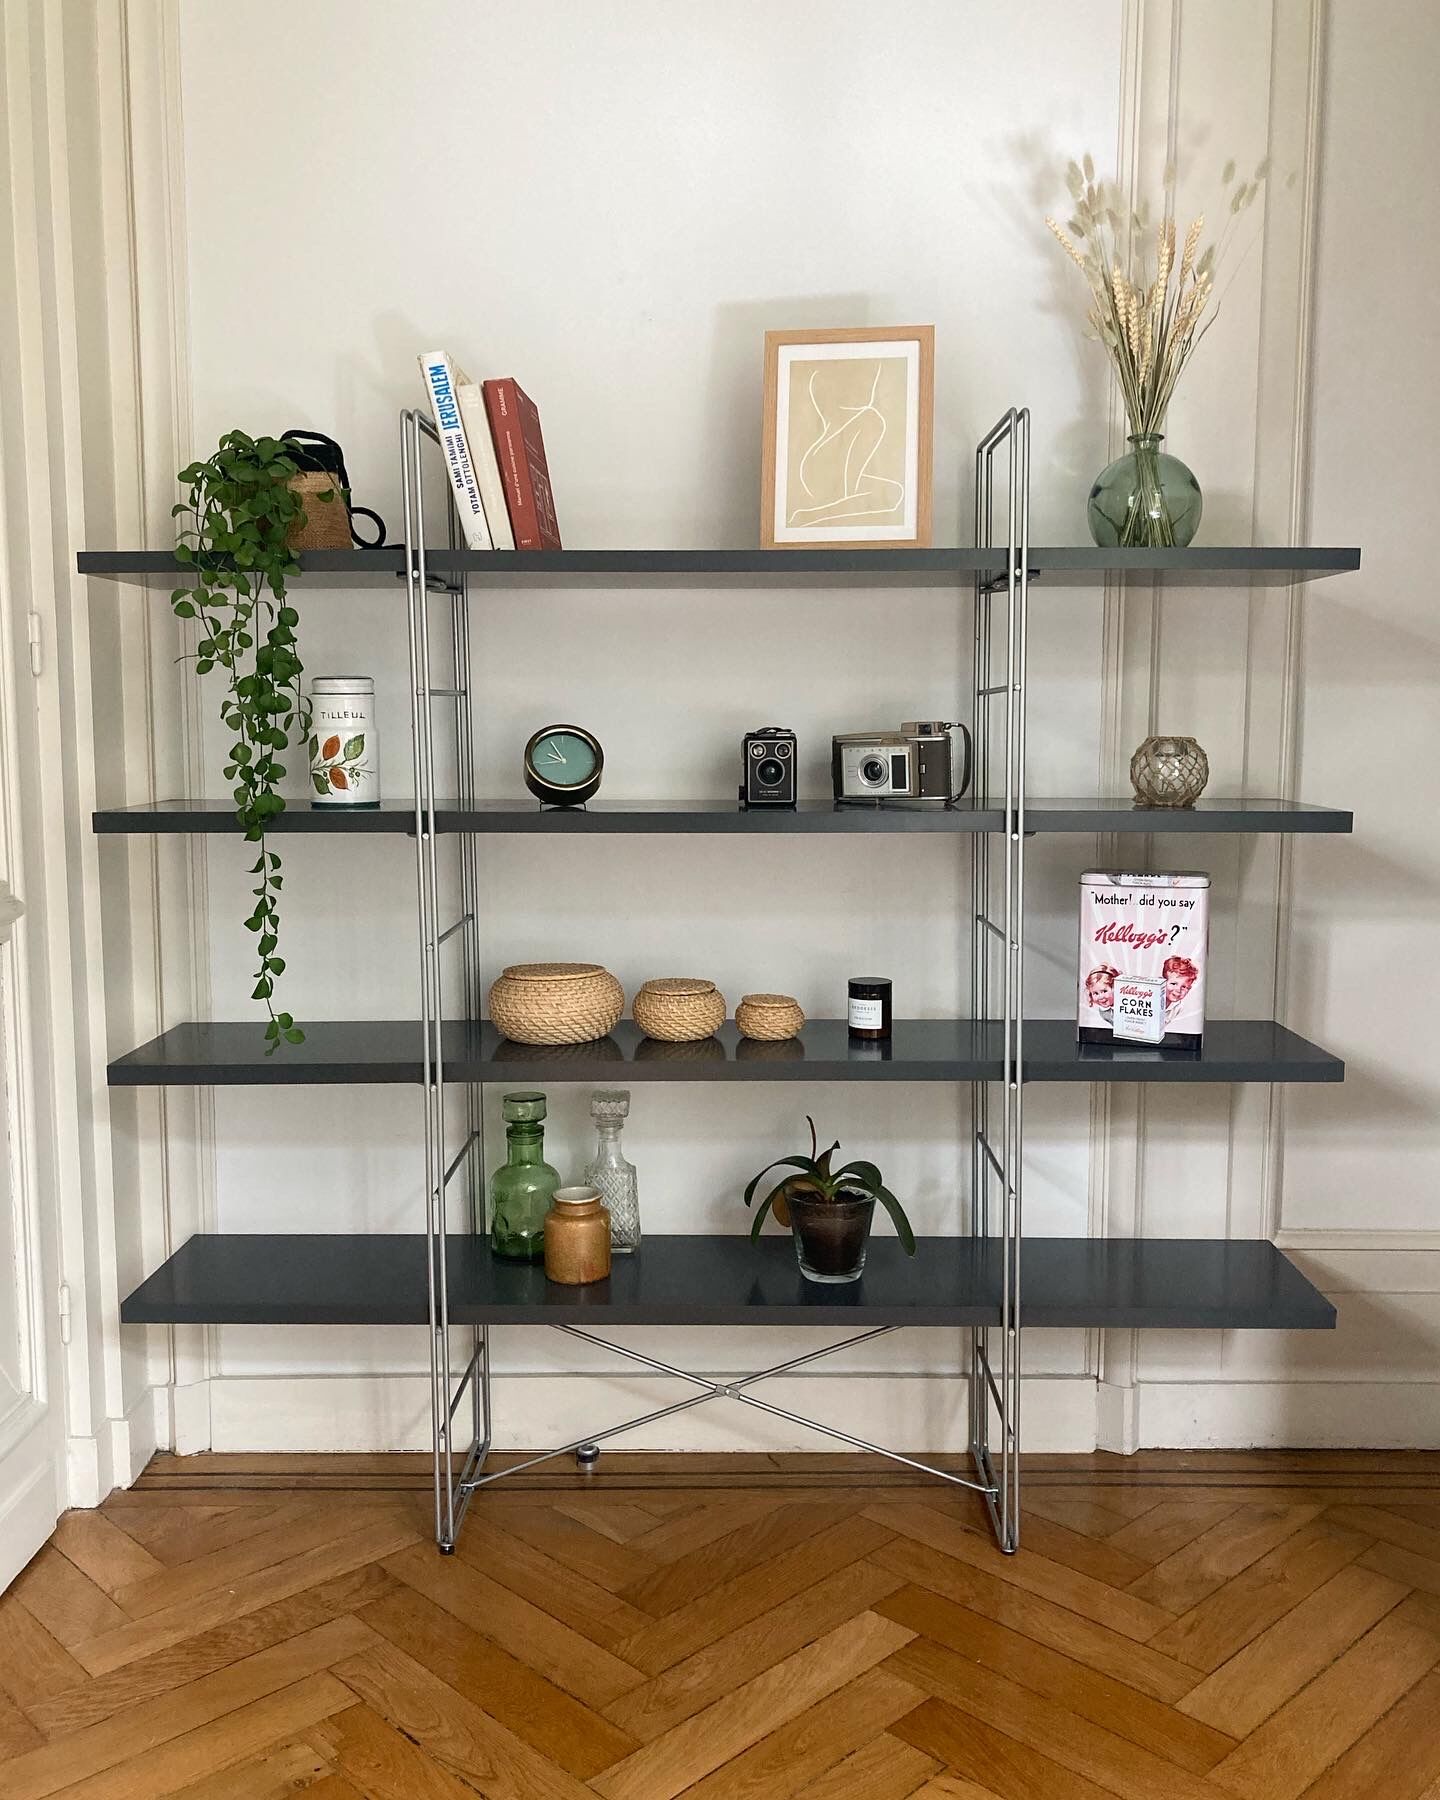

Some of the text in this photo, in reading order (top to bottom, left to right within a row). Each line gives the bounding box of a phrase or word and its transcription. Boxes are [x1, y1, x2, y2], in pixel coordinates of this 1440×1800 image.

[428, 364, 460, 430] JERUSALEM
[498, 387, 508, 417] GRAMME
[445, 435, 464, 489] SAMI TAMIMI
[455, 433, 481, 515] YOTAM OTTOLENGHI
[320, 711, 366, 720] TILLEUL
[1139, 894, 1155, 906] did
[1158, 899, 1177, 909] you
[1179, 899, 1195, 910] say
[1119, 1005, 1153, 1018] FLAKES
[1121, 998, 1152, 1008] CORN
